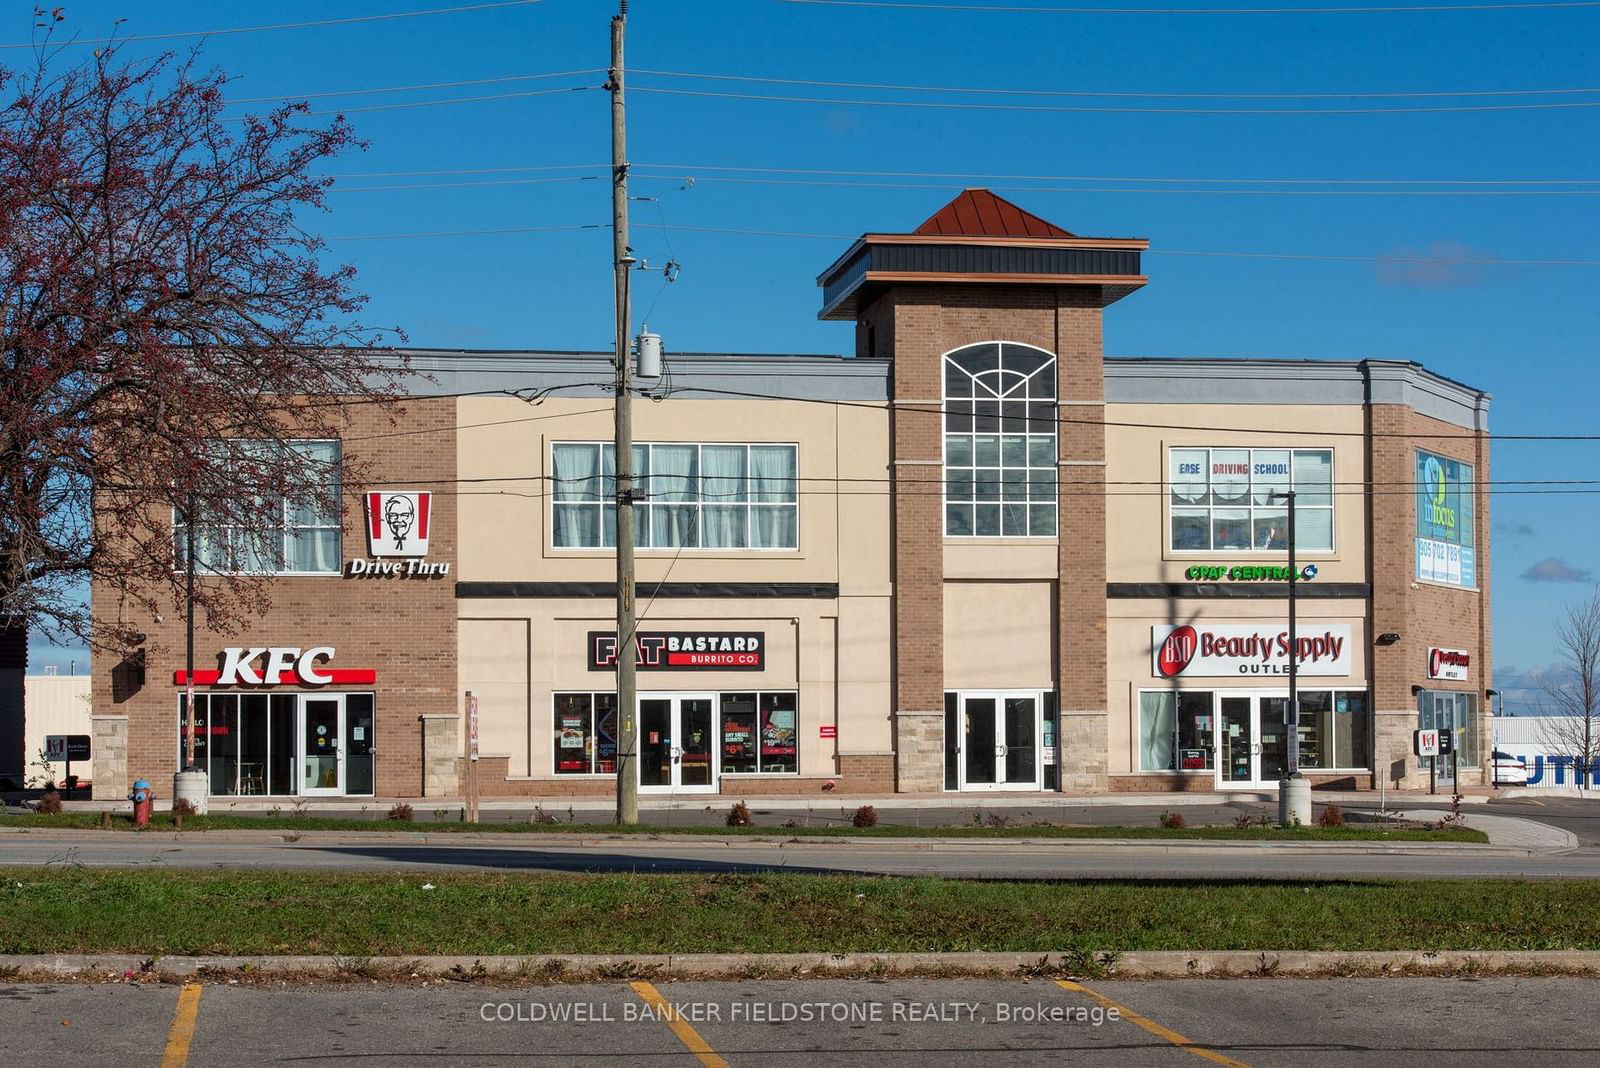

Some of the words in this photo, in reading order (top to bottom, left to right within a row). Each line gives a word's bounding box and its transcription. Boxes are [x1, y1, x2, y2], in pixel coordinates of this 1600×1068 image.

[1179, 463, 1200, 475] EASE
[1213, 463, 1248, 475] DRIVING
[1254, 463, 1288, 475] SCHOOL
[350, 556, 402, 575] Drive
[406, 558, 450, 575] Thru
[1188, 565, 1228, 580] CPAP
[668, 637, 759, 651] BASTARD
[1164, 635, 1191, 664] BSO
[1201, 632, 1273, 663] Beauty
[217, 646, 336, 685] KFC
[690, 655, 734, 664] BURRITO
[738, 655, 758, 664] CO.
